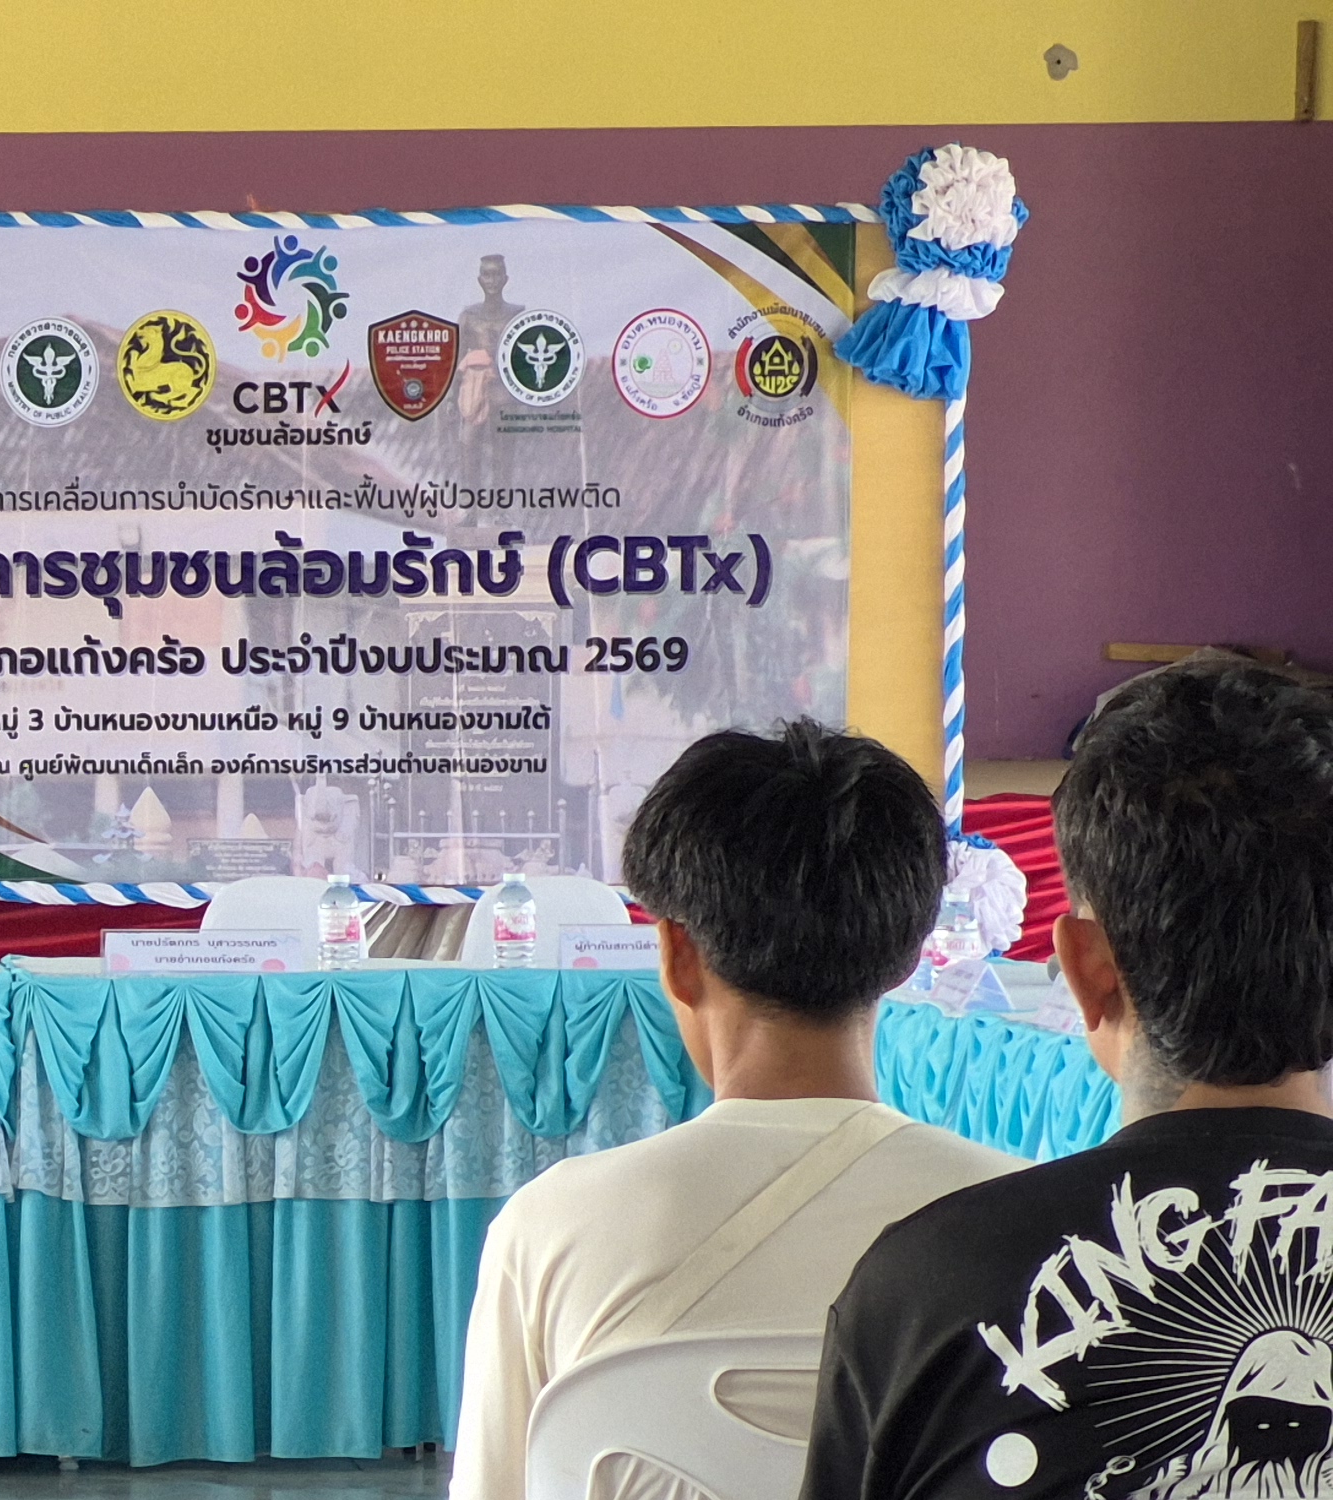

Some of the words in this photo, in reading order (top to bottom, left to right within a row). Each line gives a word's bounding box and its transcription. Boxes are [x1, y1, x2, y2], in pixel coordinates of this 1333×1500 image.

[378, 329, 449, 344] KAENGKHRO
[206, 420, 372, 454] ชุมชนล้อมรักษ์
[547, 533, 773, 610] (CBTx)
[221, 632, 569, 677] ประจำปีงบประมาณ
[584, 636, 690, 674] 2569
[28, 709, 44, 733] 3
[54, 704, 279, 733] บ้านหนองขามเหนือ
[288, 704, 323, 739] หมู่
[332, 707, 348, 732] 9
[358, 704, 552, 733] บ้านหนองขามใต้
[19, 751, 204, 782] ศูนย์พัฒนาเด็กเล็ก
[211, 751, 548, 776] องค์การบริหารส่วนตำบลหนองขาม
[977, 1172, 1224, 1412] KING
